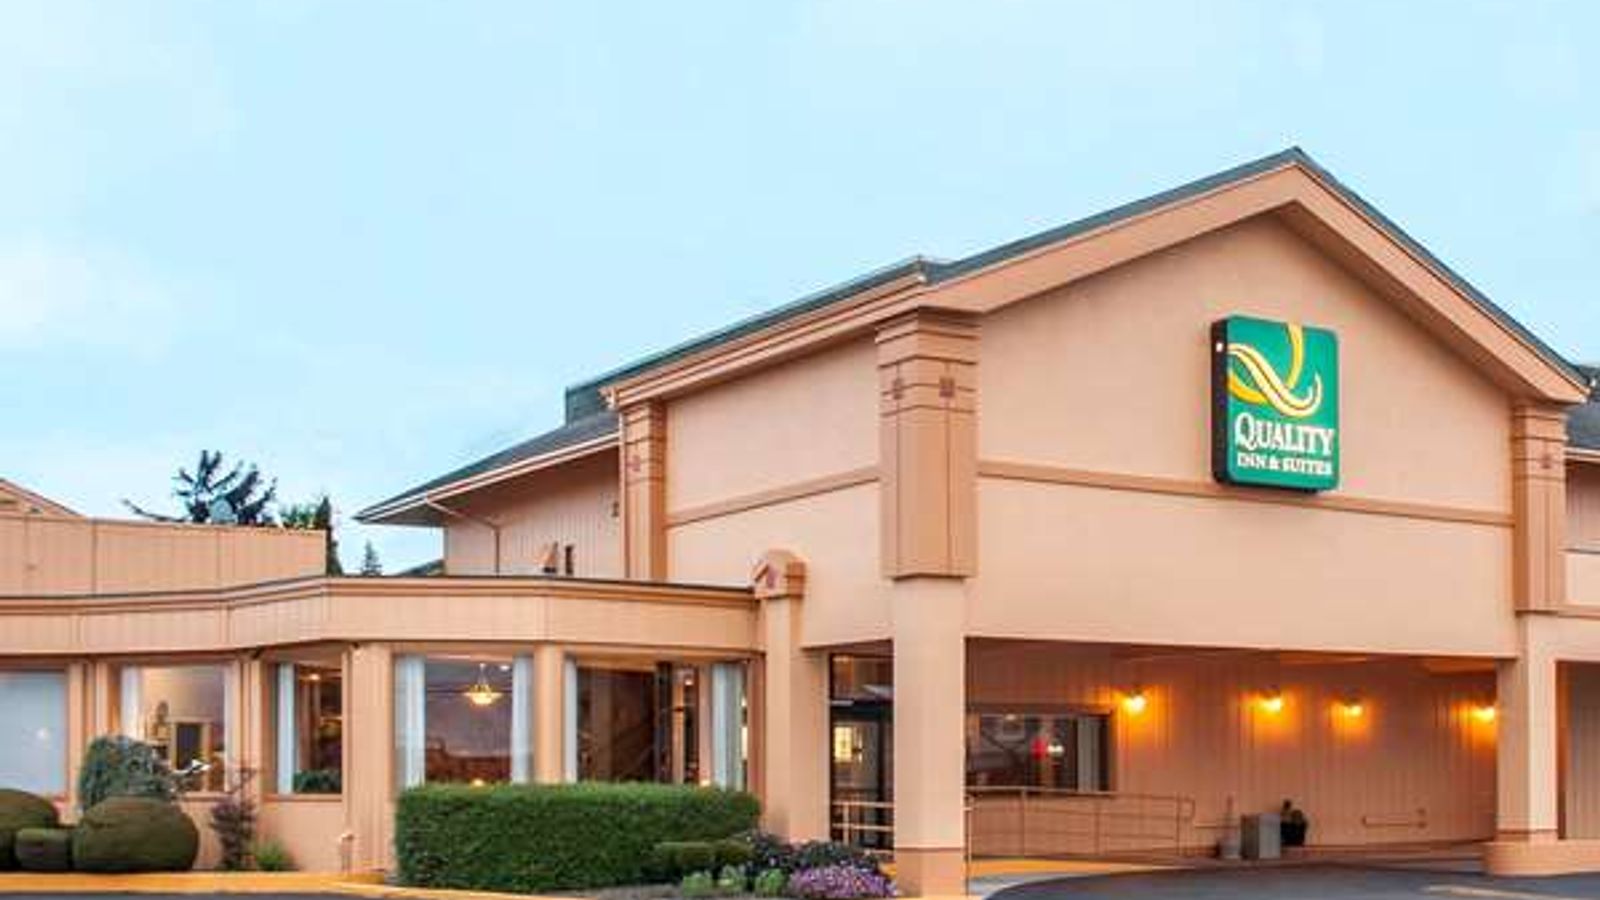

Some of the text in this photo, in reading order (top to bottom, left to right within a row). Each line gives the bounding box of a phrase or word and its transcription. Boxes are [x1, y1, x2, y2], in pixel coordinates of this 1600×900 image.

[1234, 412, 1335, 455] QUALITY
[1237, 452, 1333, 475] INN & SUITES
